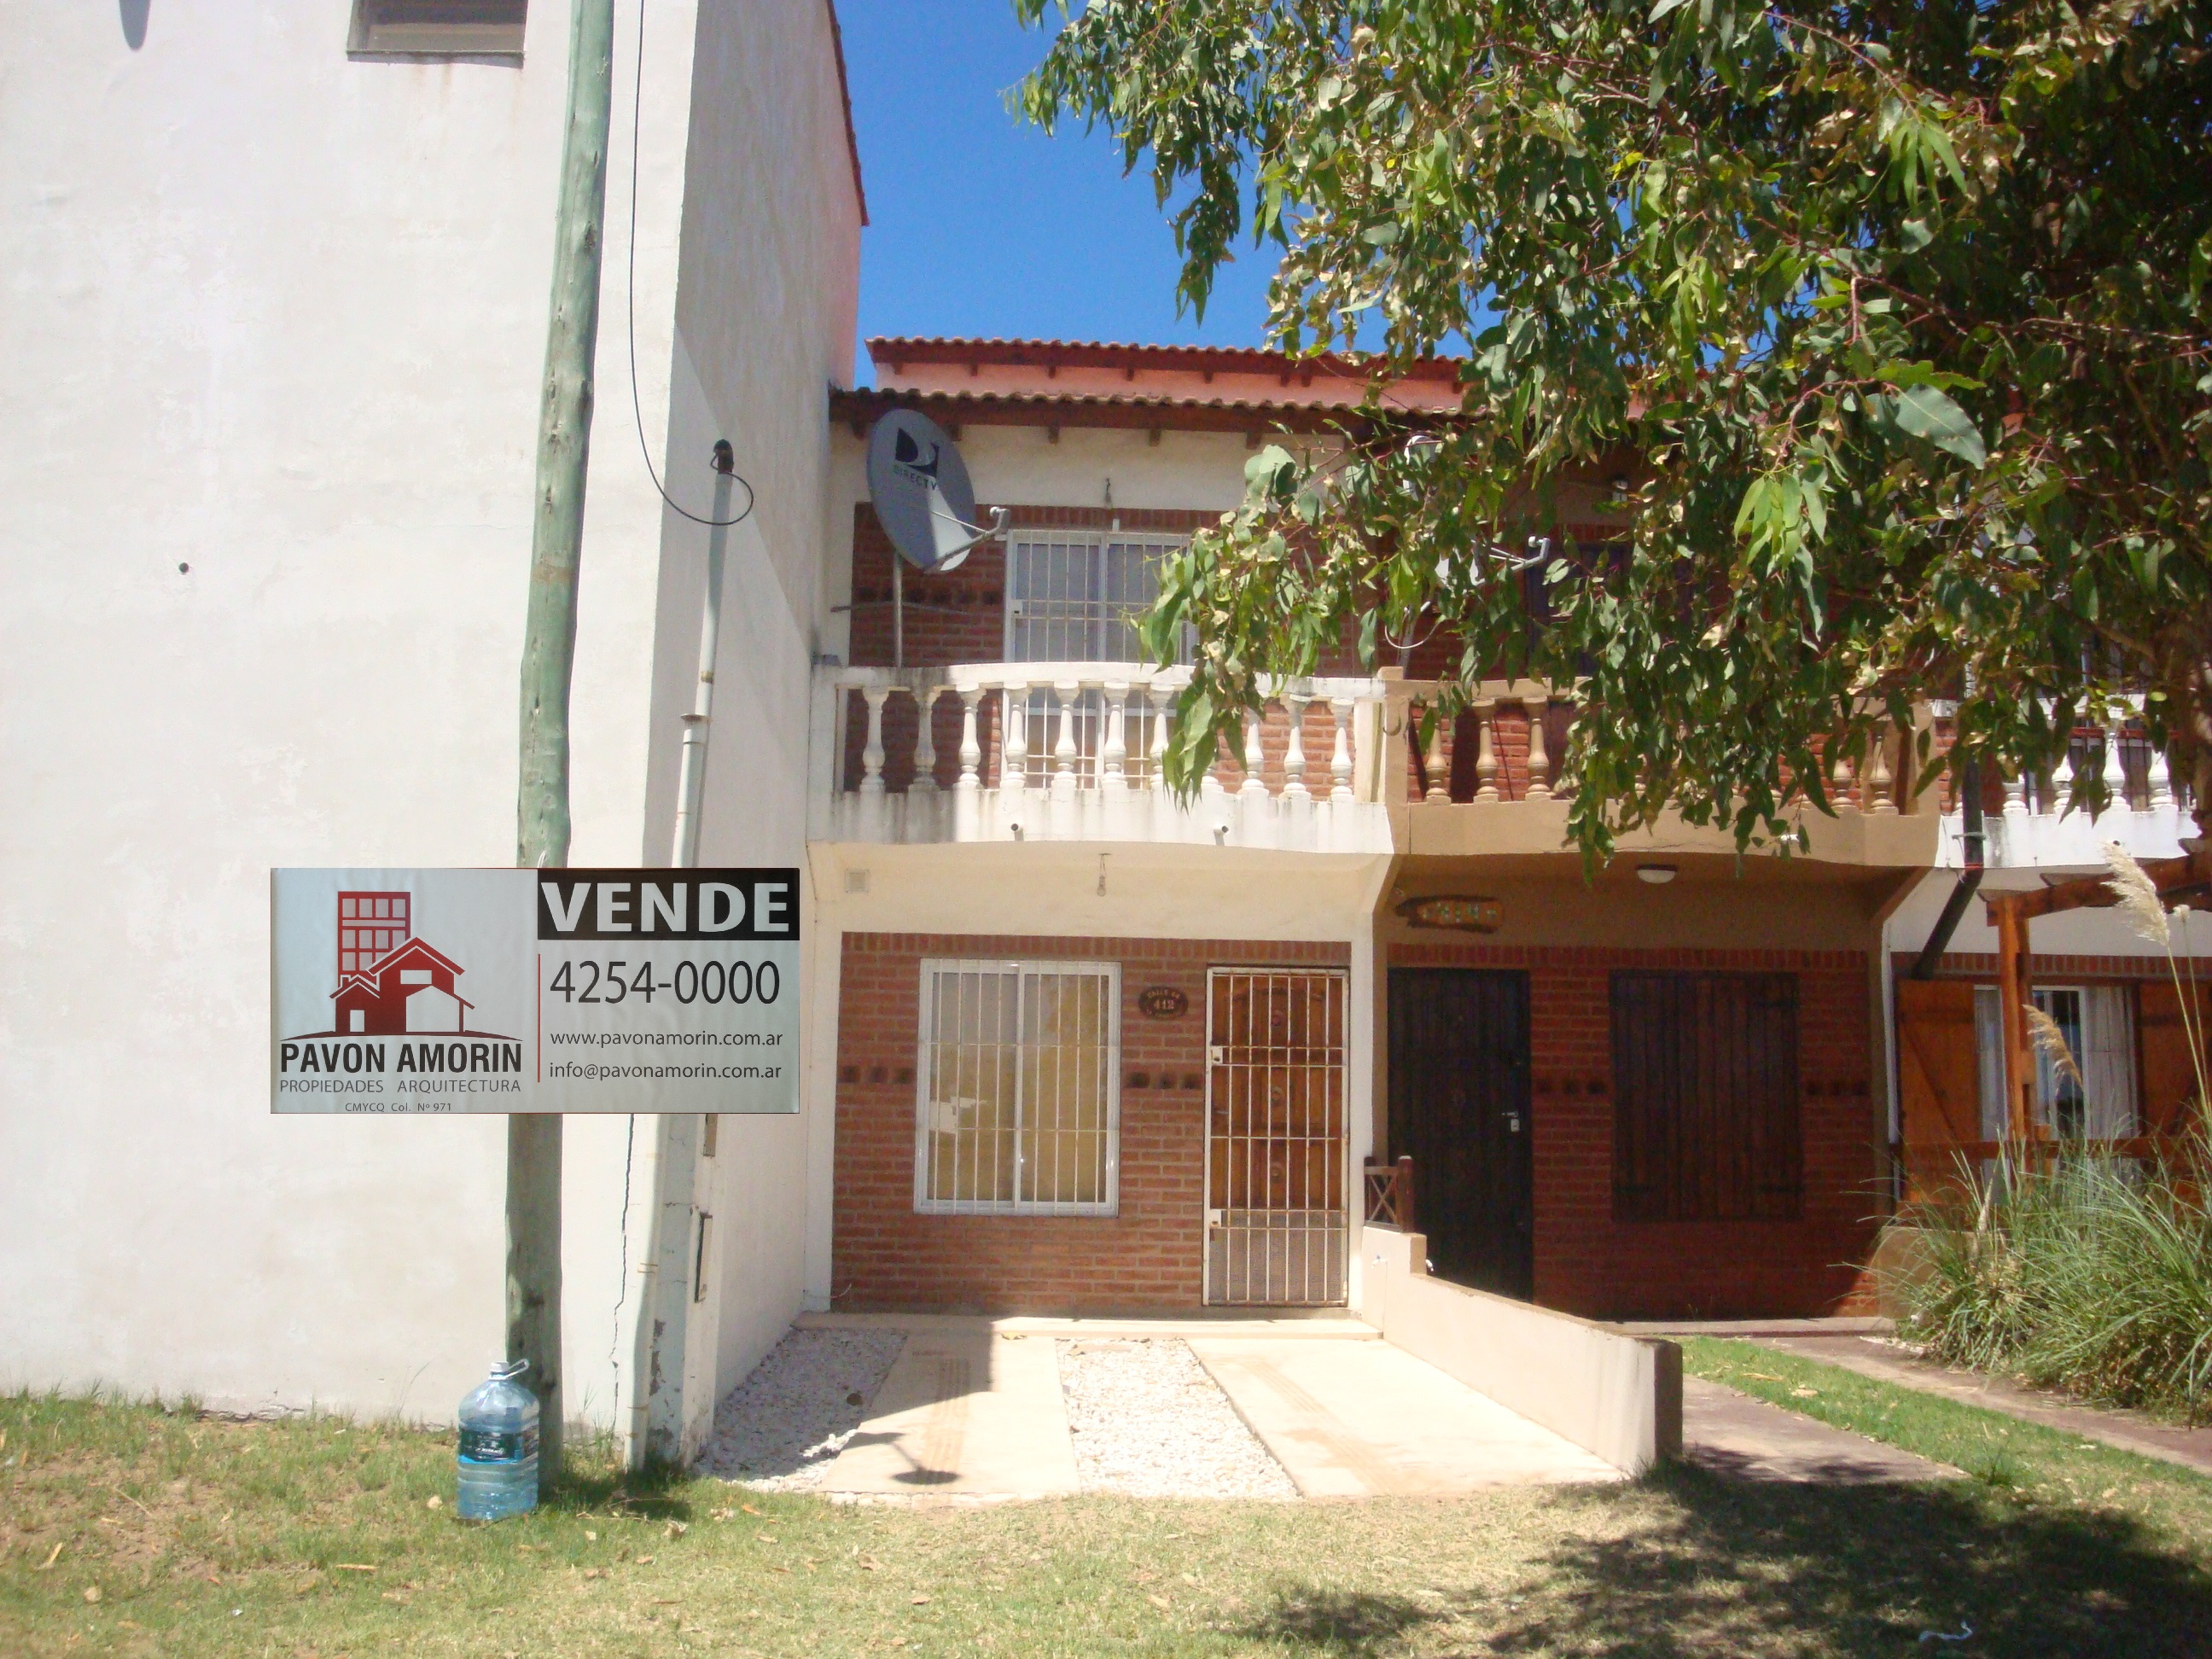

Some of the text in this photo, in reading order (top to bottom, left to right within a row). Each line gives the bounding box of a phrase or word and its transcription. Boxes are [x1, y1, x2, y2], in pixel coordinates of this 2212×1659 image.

[540, 882, 789, 933] VENDE
[550, 960, 780, 1004] 4254-0000
[550, 1031, 783, 1048] www.pavonamorin.com.ar
[281, 1043, 521, 1073] PAVON AMORIN
[550, 1062, 782, 1080] info@pavonamorin.com.ar
[280, 1080, 521, 1094] PROPIEDADES ARQUITECTURA
[345, 1103, 385, 1113] CMYCQ
[391, 1103, 411, 1112] Col.
[433, 1103, 451, 1112] 971
